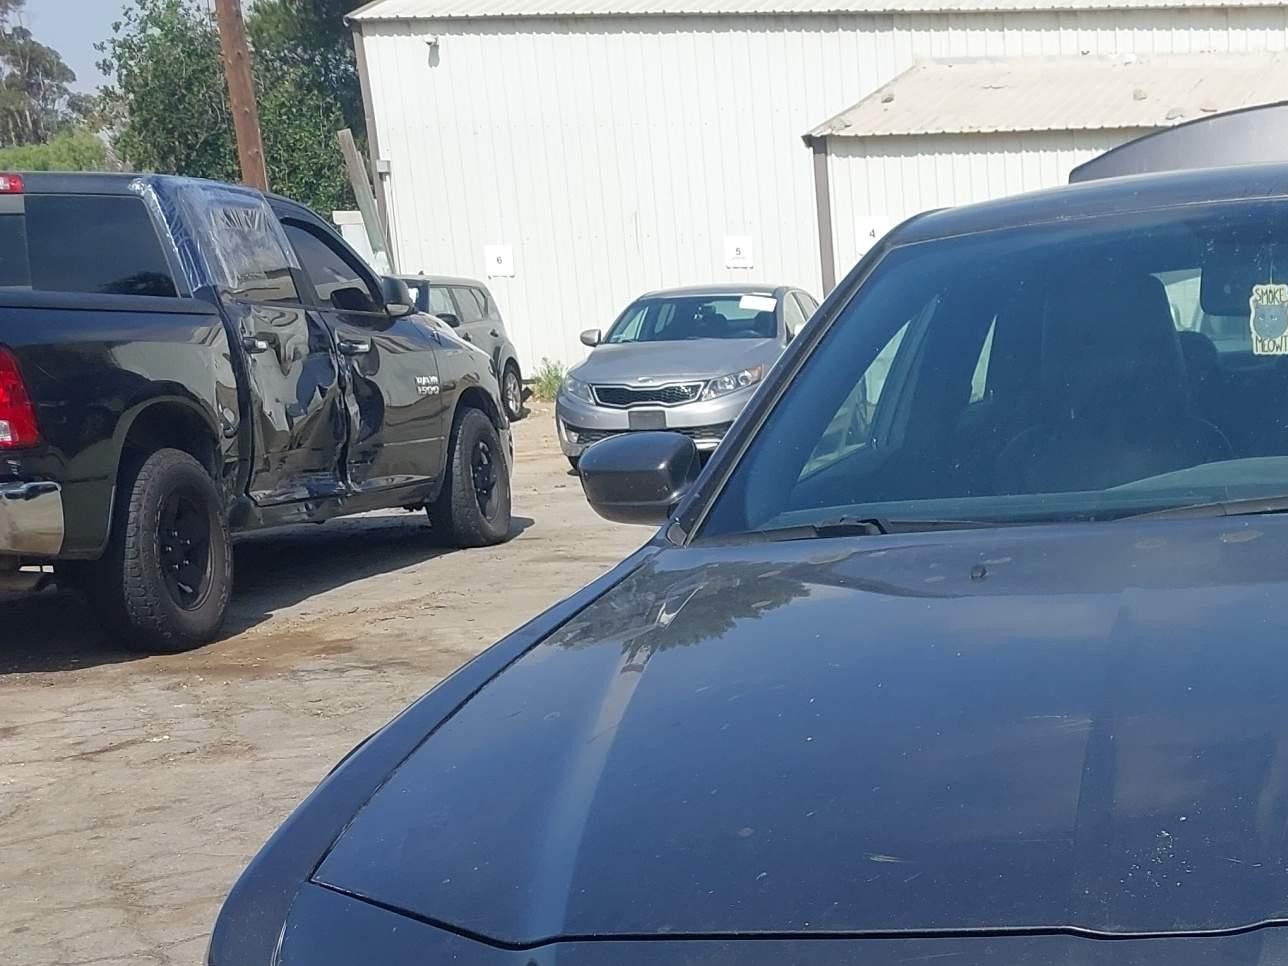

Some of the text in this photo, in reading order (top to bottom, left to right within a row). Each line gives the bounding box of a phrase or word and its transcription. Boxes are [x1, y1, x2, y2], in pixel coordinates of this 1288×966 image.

[496, 256, 503, 265] 6
[1254, 287, 1288, 305] SMOKE
[1255, 335, 1288, 353] MEOWT
[417, 385, 440, 395] 1500
